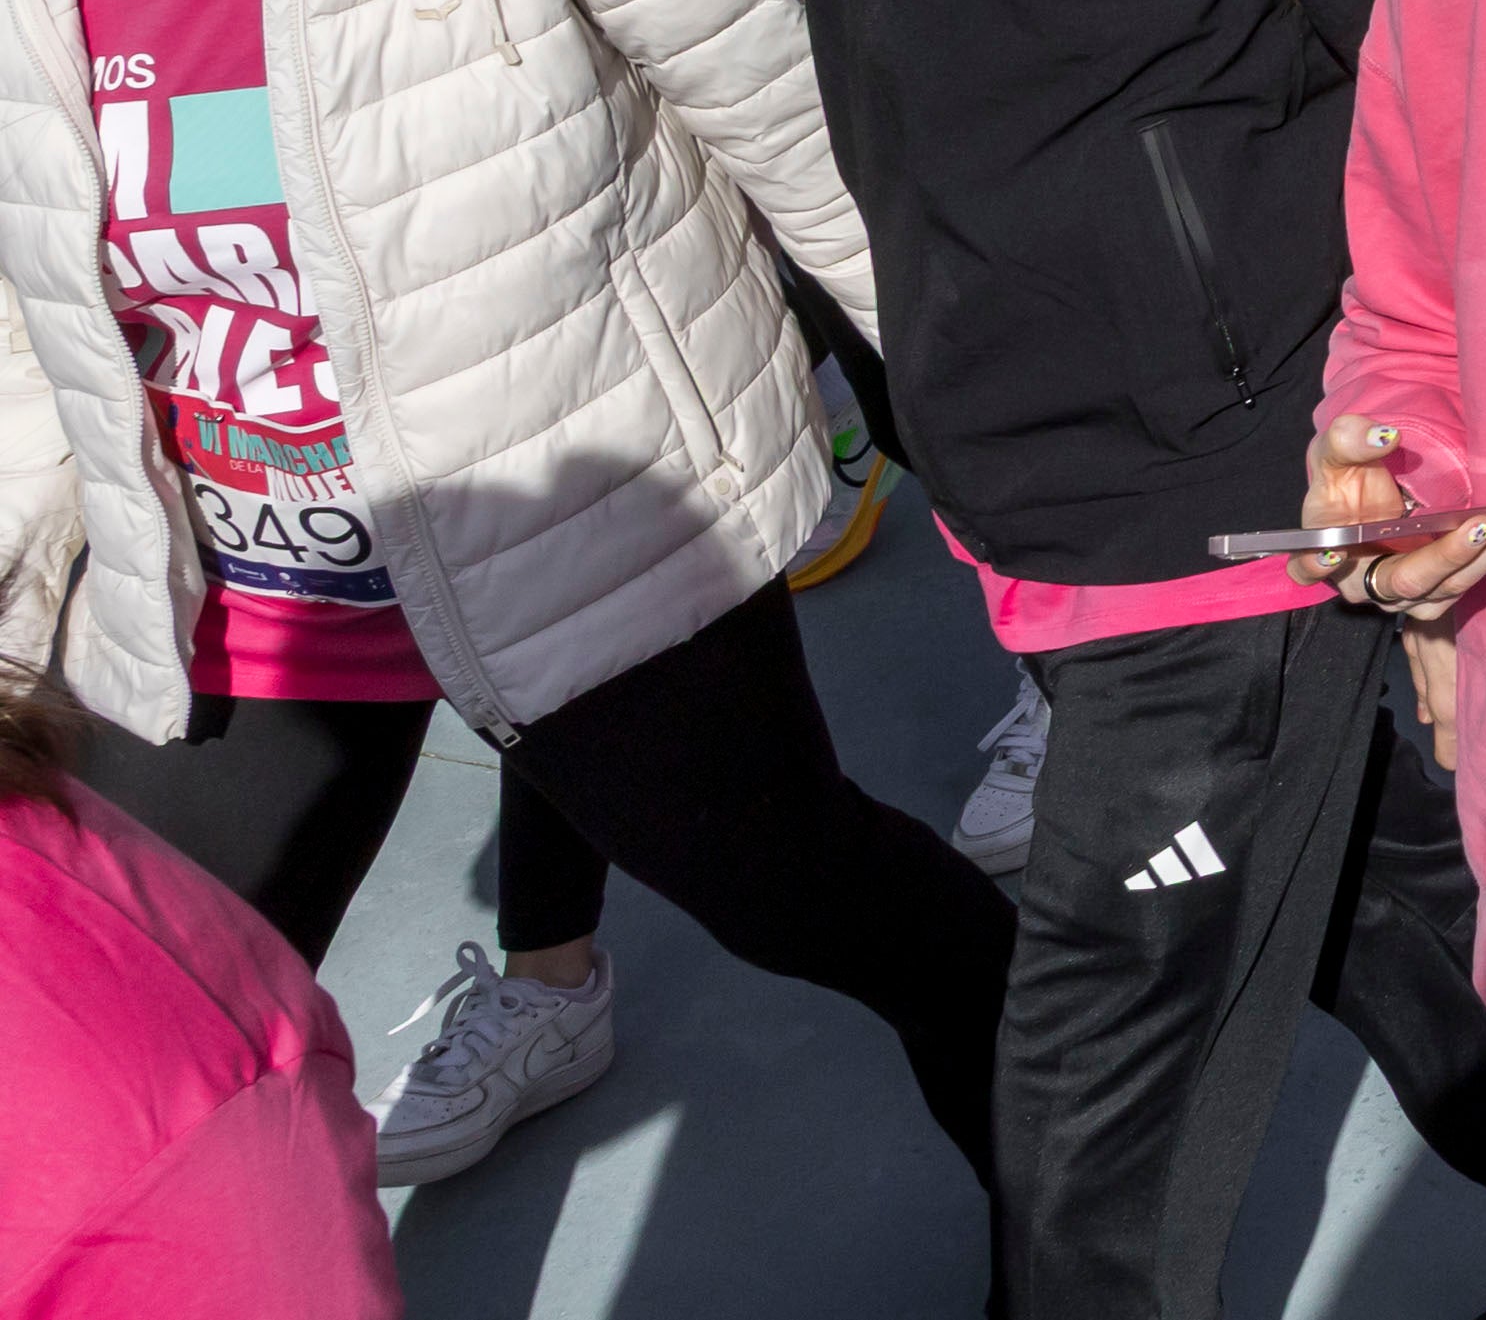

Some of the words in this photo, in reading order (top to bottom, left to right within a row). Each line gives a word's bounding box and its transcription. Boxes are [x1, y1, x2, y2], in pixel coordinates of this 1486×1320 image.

[229, 459, 247, 472] DE
[248, 461, 264, 474] LA
[265, 466, 354, 503] MUJE
[195, 482, 373, 566] 349
